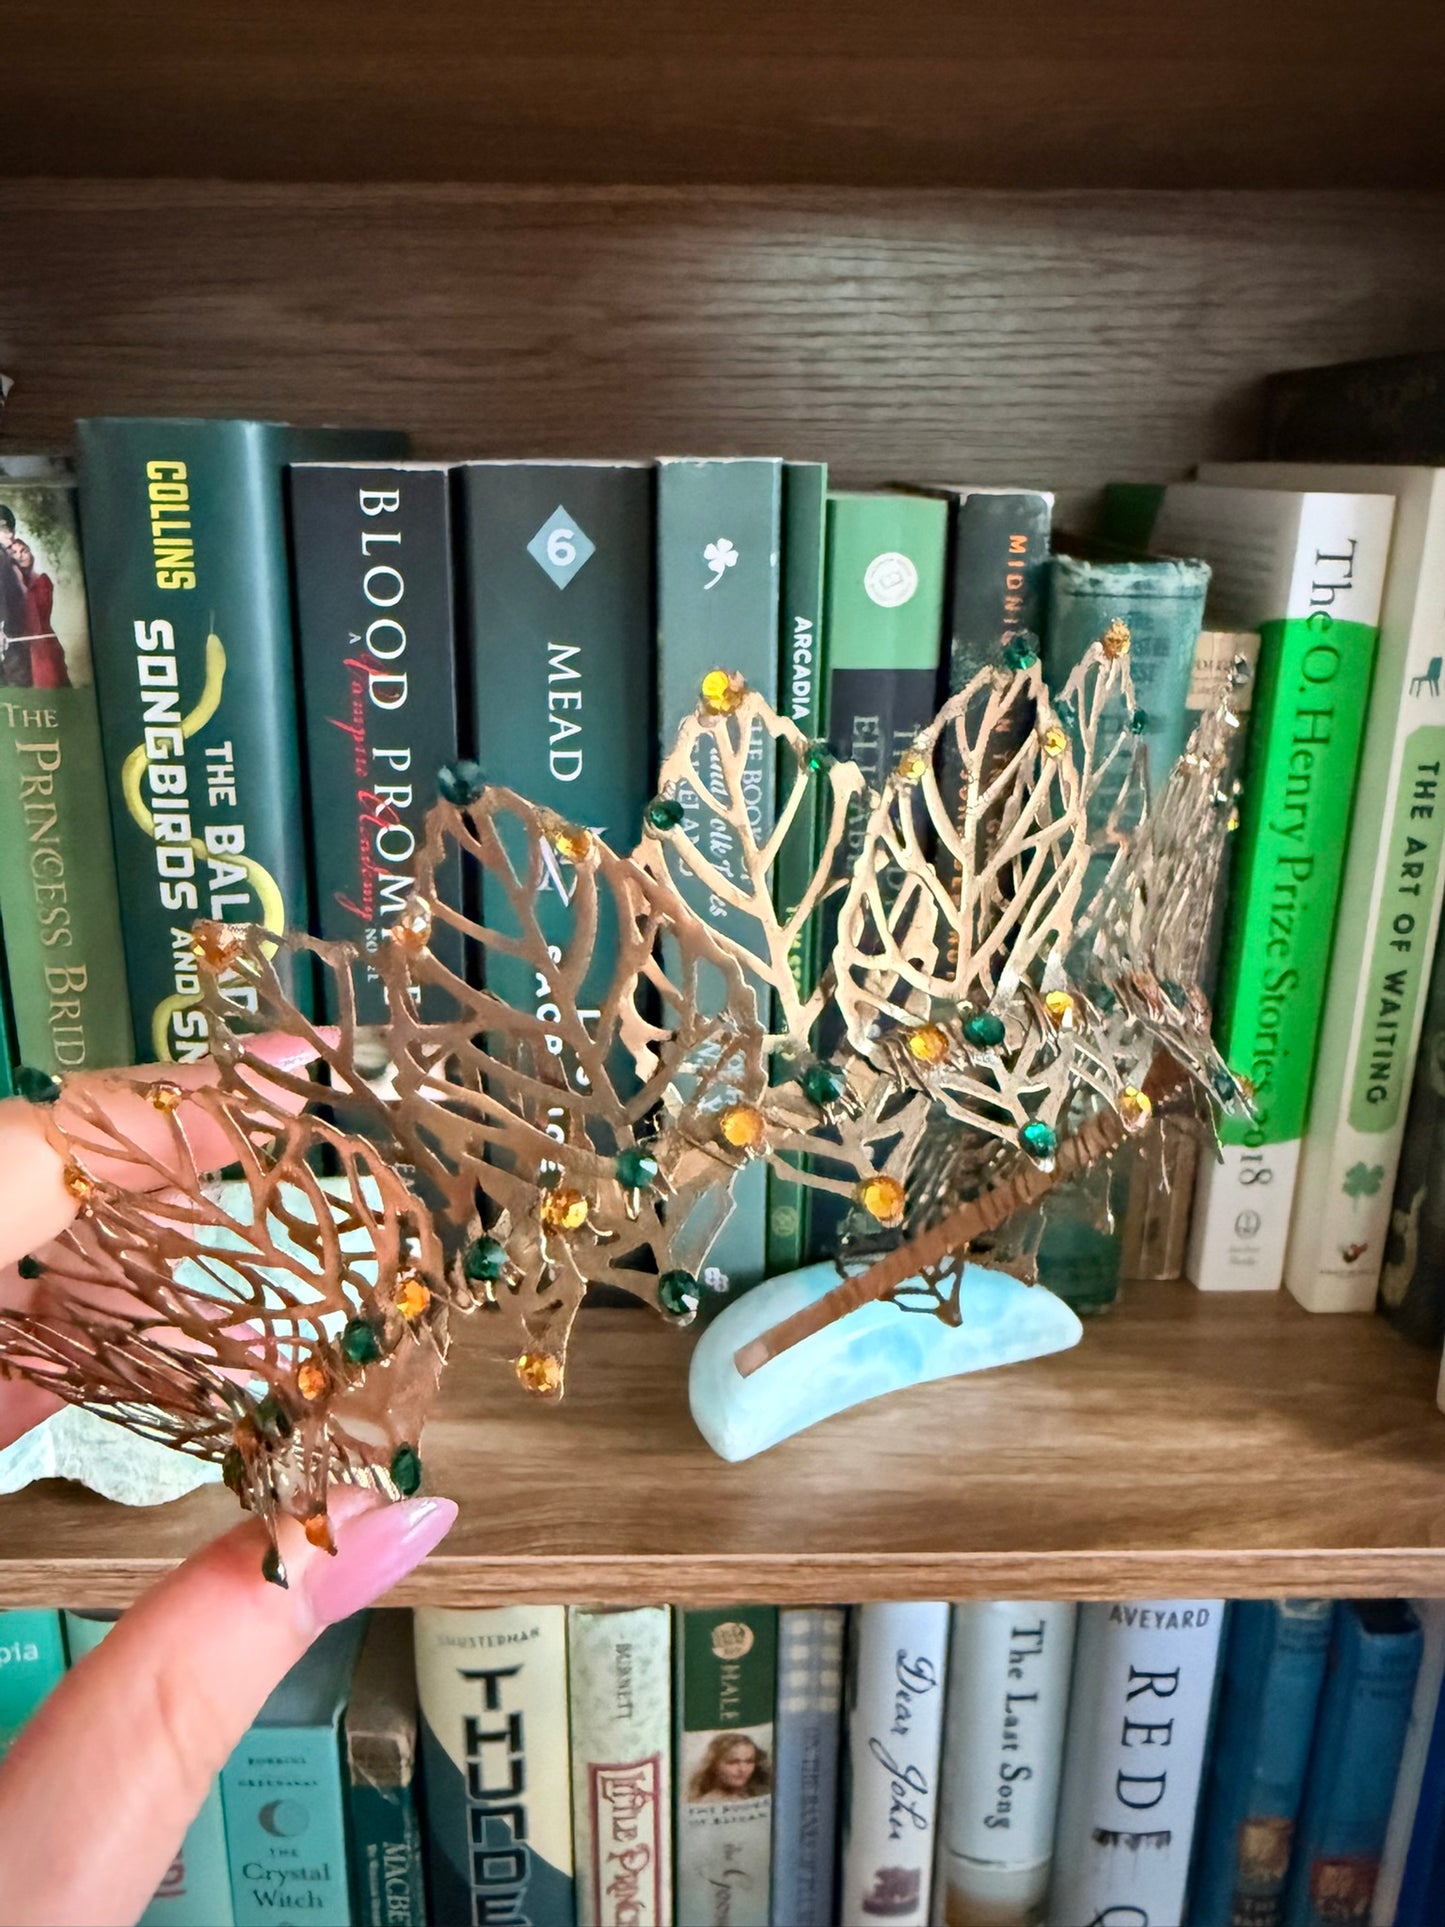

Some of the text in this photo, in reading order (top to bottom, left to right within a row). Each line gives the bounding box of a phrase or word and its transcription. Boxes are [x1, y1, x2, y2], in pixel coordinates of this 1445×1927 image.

[146, 459, 197, 591] COLLINS
[546, 528, 577, 566] 6
[1306, 538, 1359, 632] The
[358, 488, 409, 711] BLOOD
[6, 704, 59, 729] THE
[546, 641, 584, 782] MEAD
[791, 616, 814, 720] ARCADIA
[1298, 644, 1342, 693] O.
[134, 618, 199, 911] SONGBIRDS
[170, 927, 200, 995] AND
[203, 742, 238, 807] THE
[1269, 707, 1336, 842] Henry
[14, 738, 73, 949] PRINCESS
[1266, 854, 1316, 958] Prize
[1365, 760, 1441, 1105] THE ART OF WAITING
[1250, 968, 1301, 1095] Stories
[1109, 1604, 1210, 1630] AVEYARD
[868, 1648, 939, 1841] Dear John
[983, 1619, 1047, 1830] The Last Song
[1116, 1664, 1181, 1810] RED
[242, 1862, 332, 1887] Crystal
[252, 1888, 324, 1910] Witch
